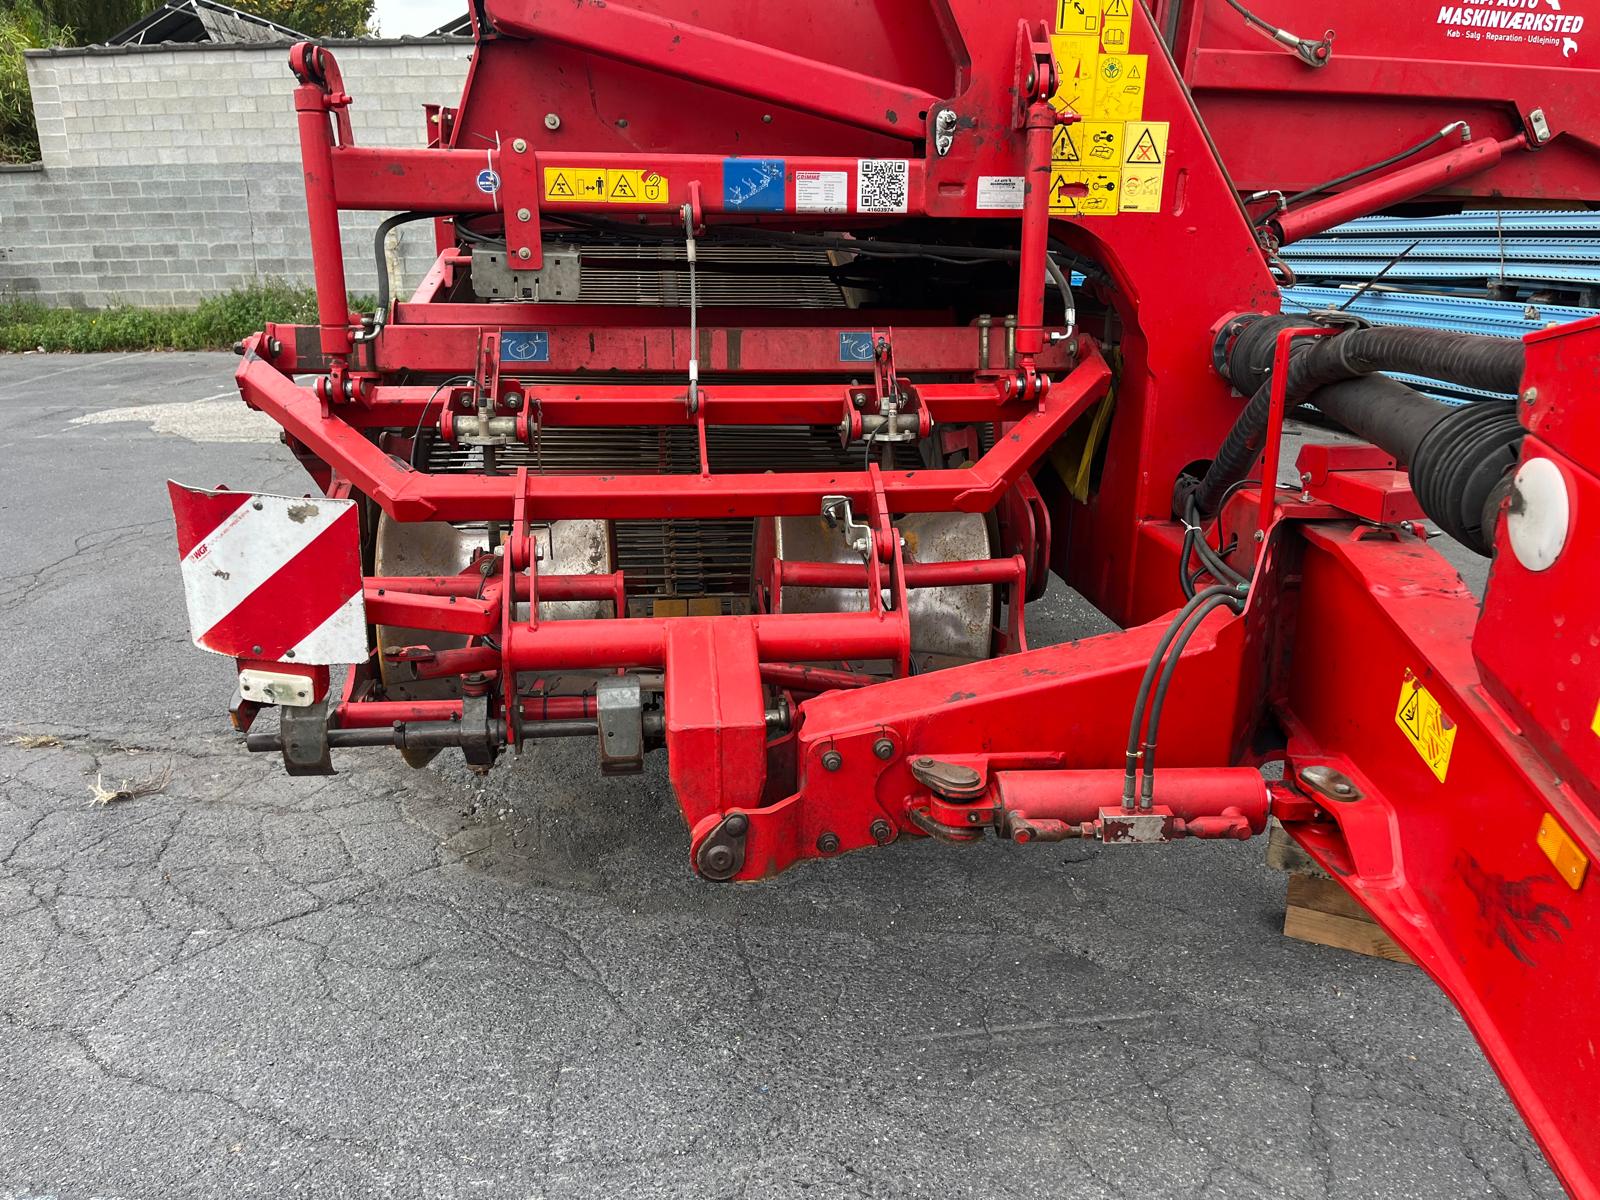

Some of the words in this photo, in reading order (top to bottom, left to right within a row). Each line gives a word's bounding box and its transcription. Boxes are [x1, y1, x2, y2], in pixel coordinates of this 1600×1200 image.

[1437, 6, 1584, 34] MASKINVÆRKSTED
[1466, 31, 1481, 40] Salg
[1486, 32, 1523, 43] Reparation
[1527, 35, 1560, 46] Udlejning
